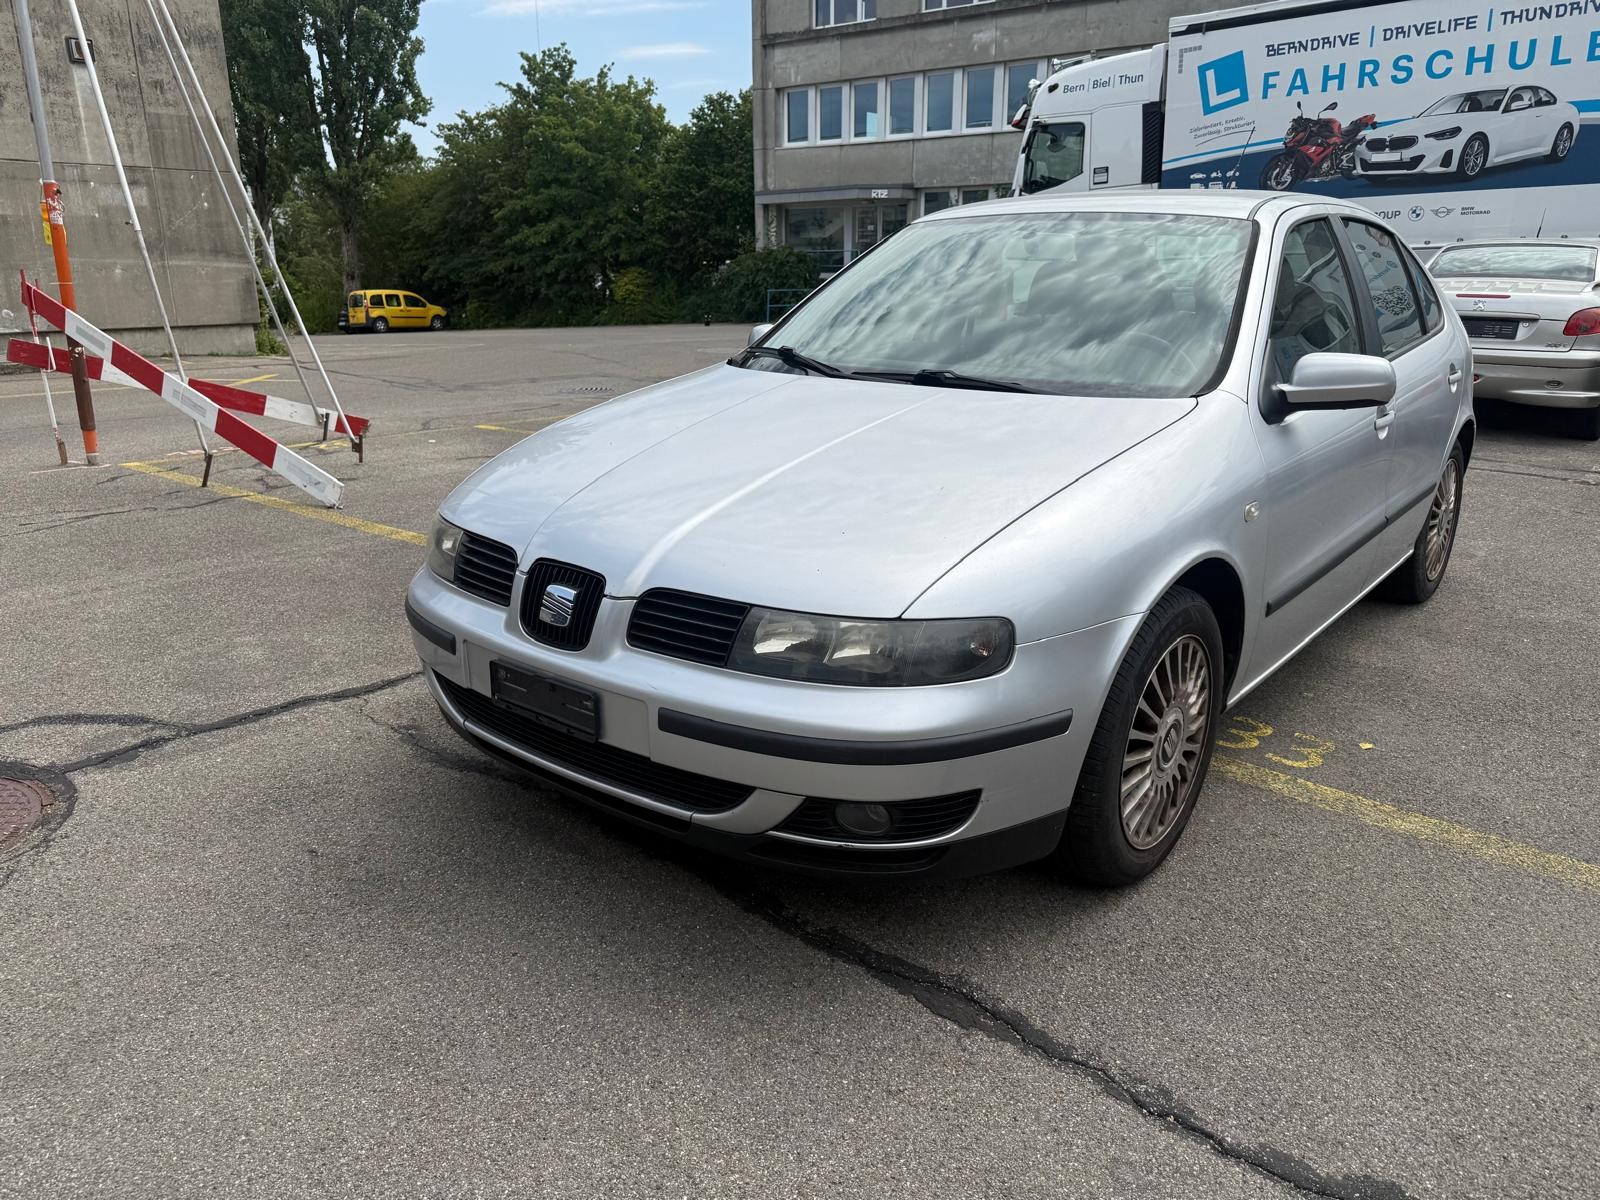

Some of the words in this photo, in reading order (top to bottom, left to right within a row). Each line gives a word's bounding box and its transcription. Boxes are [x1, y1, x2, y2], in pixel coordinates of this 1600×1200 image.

[1265, 32, 1361, 57] BERNDRIVE
[1382, 15, 1478, 41] DRIVELIFE
[1063, 83, 1085, 94] Bern
[1092, 76, 1111, 90] Biel
[1118, 73, 1144, 85] Thun
[1262, 31, 1600, 100] FAHRSCHULE
[1205, 68, 1241, 108] L
[1375, 210, 1401, 219] OUP
